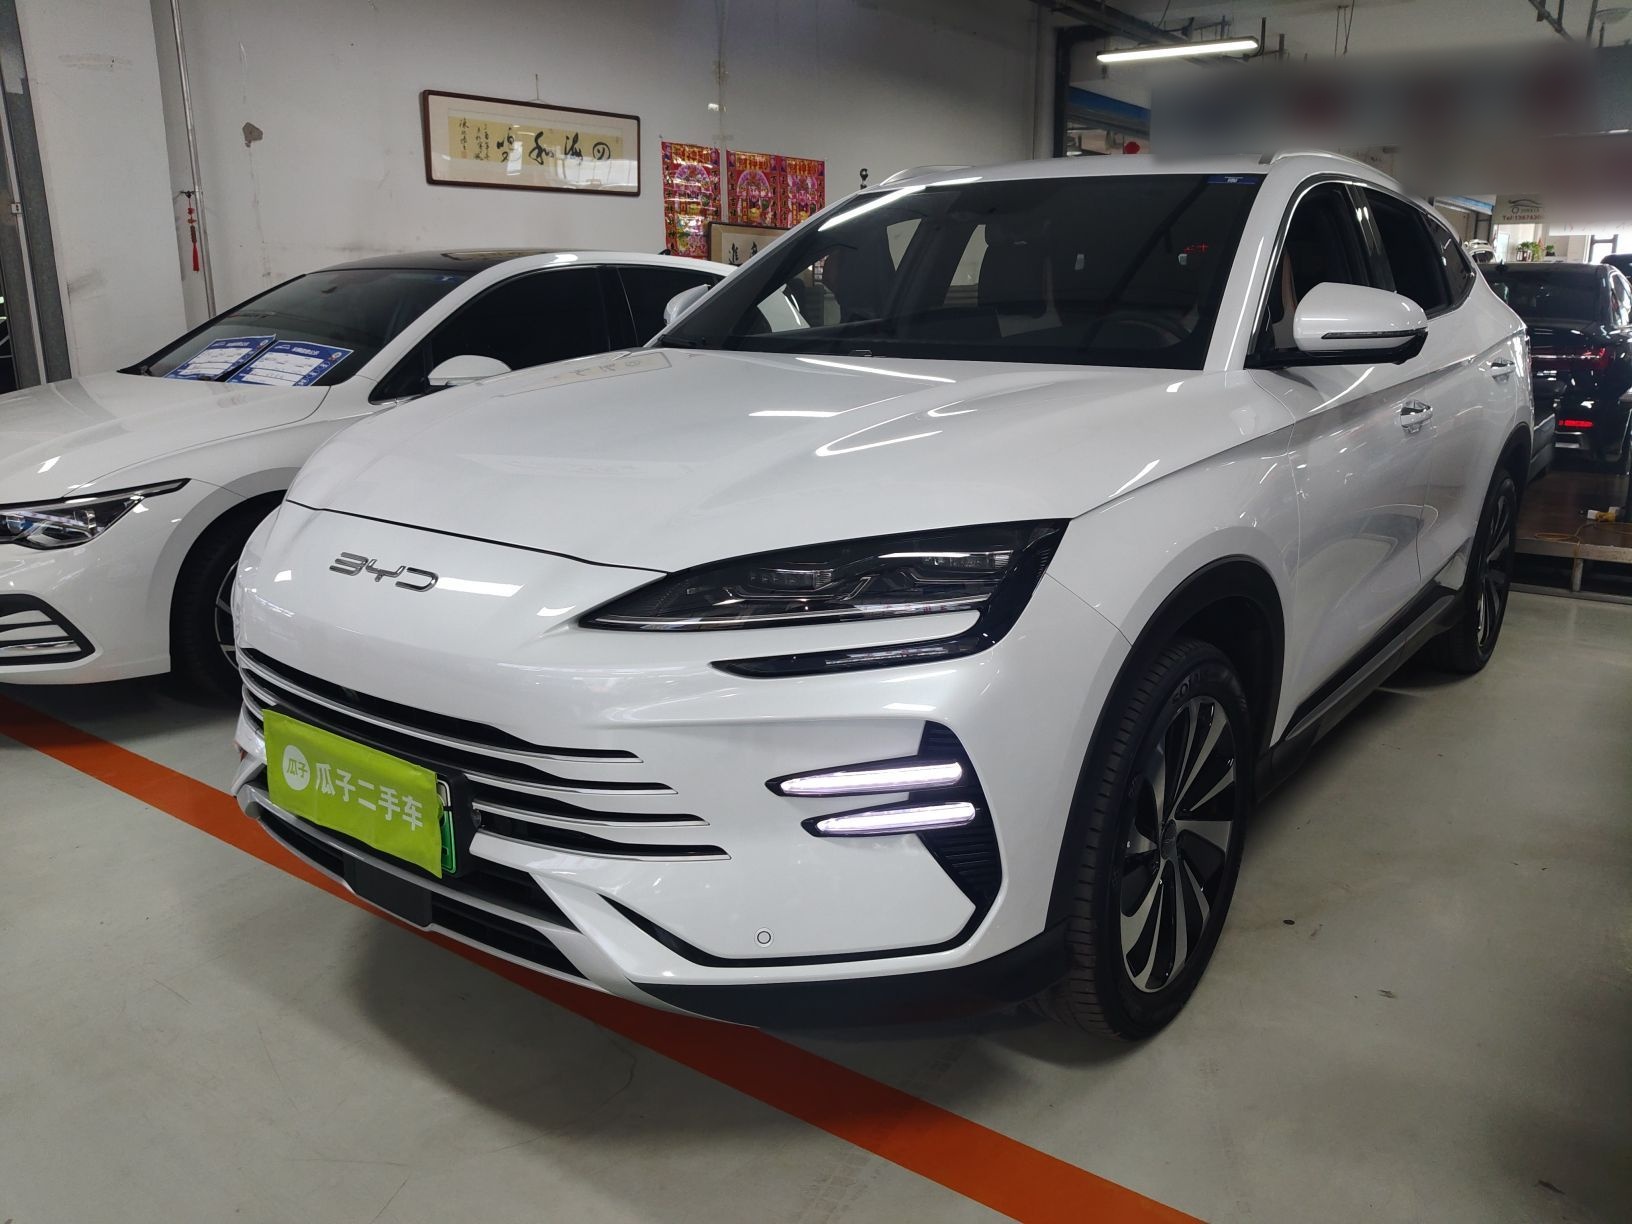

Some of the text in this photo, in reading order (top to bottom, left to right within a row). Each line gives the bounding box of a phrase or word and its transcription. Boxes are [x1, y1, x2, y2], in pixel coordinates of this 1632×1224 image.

[329, 551, 439, 592] BYD
[286, 758, 309, 779] 瓜子
[315, 762, 424, 831] 瓜子二手车
